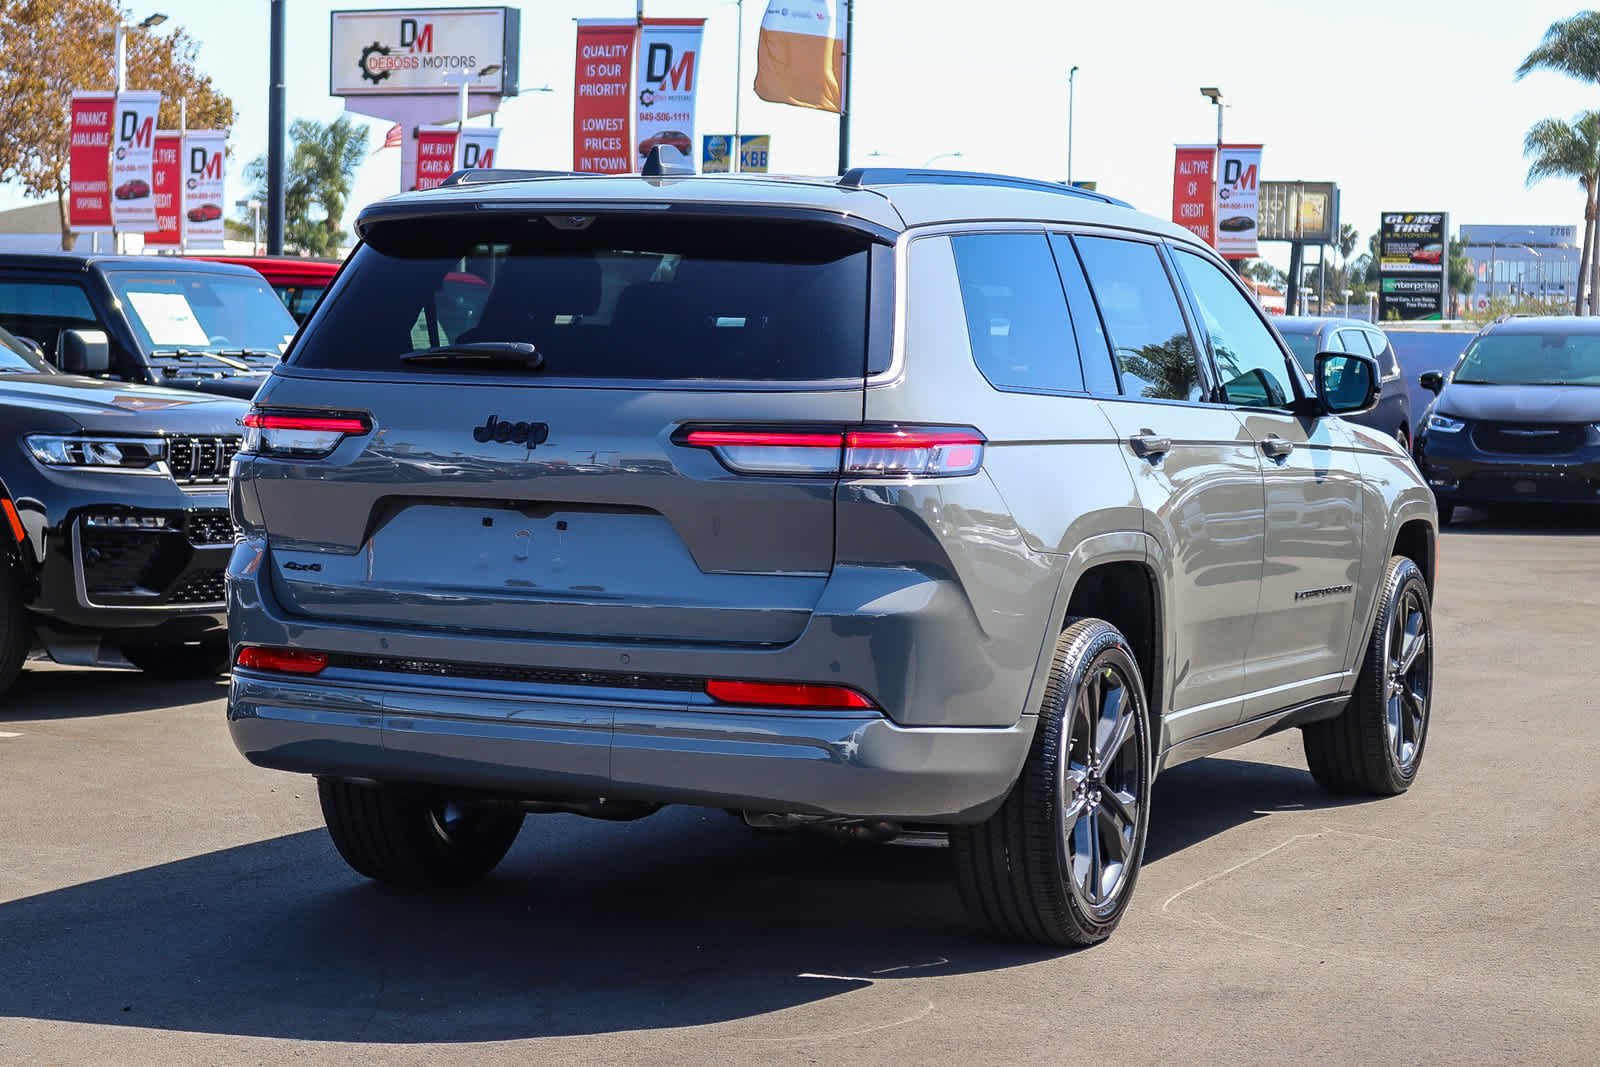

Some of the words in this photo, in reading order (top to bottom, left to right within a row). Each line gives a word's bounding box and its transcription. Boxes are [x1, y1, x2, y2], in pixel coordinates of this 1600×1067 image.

[401, 19, 433, 53] DM
[583, 45, 628, 58] QUALITY
[368, 56, 419, 70] DEBOSS
[423, 56, 477, 68] MOTORS
[646, 42, 695, 92] DM
[587, 64, 595, 76] IS
[598, 64, 621, 77] OUR
[580, 83, 627, 96] PRIORITY
[76, 111, 107, 126] FINANCE
[640, 111, 690, 121] 949-506-1111
[121, 110, 153, 149] DM
[583, 118, 624, 130] LOWEST
[72, 132, 109, 147] AVAILABLE
[585, 138, 621, 150] PRICES
[160, 149, 176, 163] TYPE
[422, 143, 434, 154] WE
[436, 143, 454, 155] BUY
[191, 147, 222, 180] DM
[422, 160, 443, 172] CARS
[444, 161, 451, 172] &
[581, 157, 592, 169] IN
[594, 157, 627, 170] TOWN
[741, 151, 768, 168] KBB
[1180, 161, 1191, 174] ALL
[1193, 160, 1209, 175] TYPE
[156, 171, 166, 185] OF
[1224, 160, 1257, 190] DM
[419, 177, 443, 190] TRUC
[1188, 181, 1198, 196] OF
[1181, 203, 1205, 217] CREDIT
[158, 215, 176, 230] COME
[1393, 224, 1432, 233] TIRE
[1387, 281, 1439, 290] enterprise
[473, 415, 549, 450] Jeep
